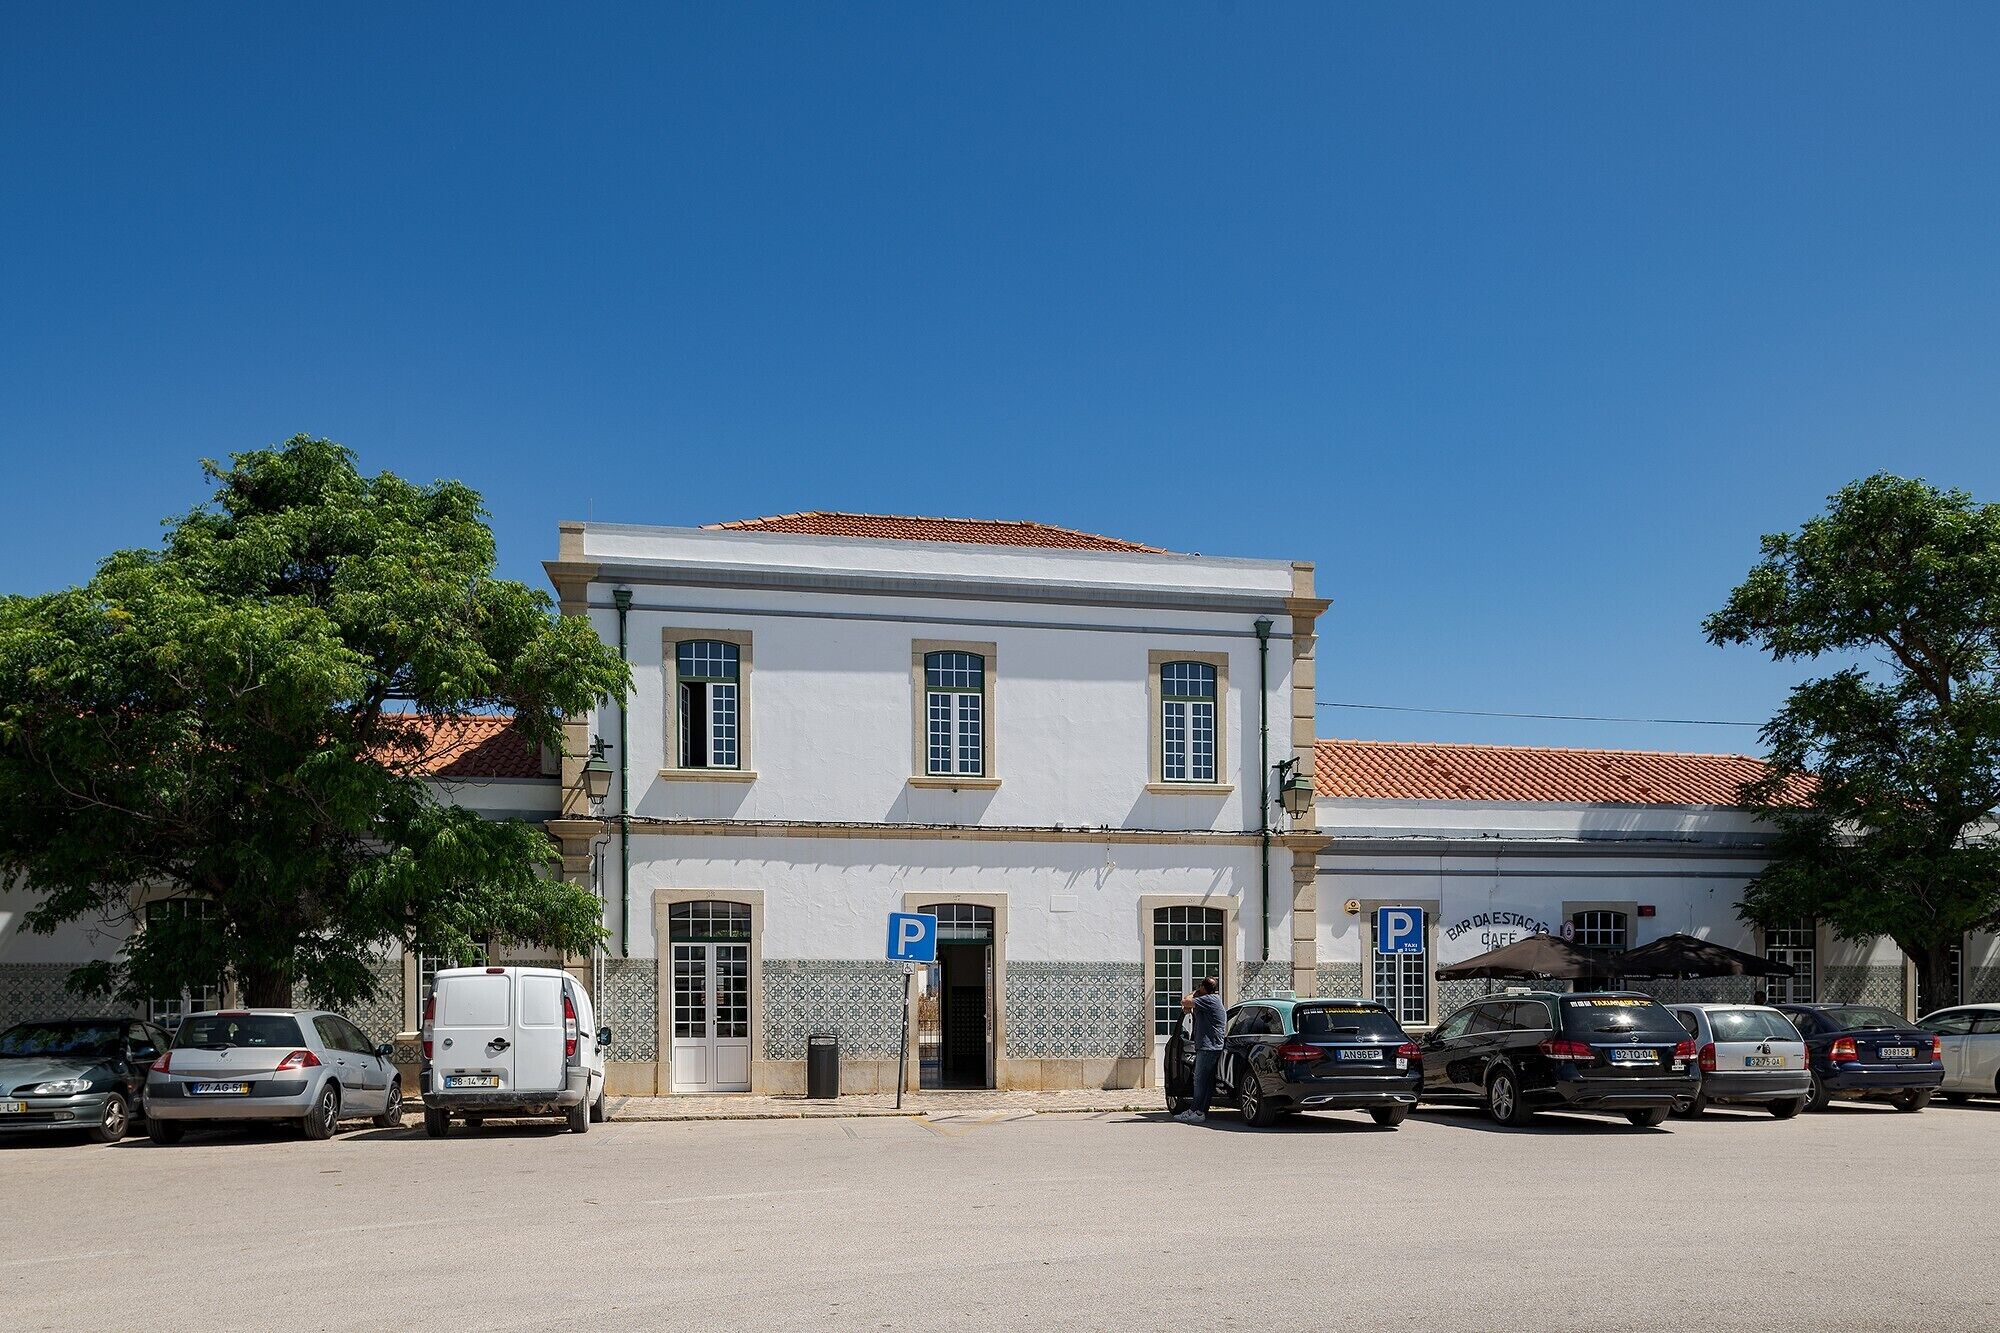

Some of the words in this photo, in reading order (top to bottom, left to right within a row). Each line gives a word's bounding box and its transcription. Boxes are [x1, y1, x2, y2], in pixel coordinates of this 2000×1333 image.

[897, 917, 926, 956] P
[1388, 911, 1413, 950] P
[1446, 919, 1472, 942] BAR
[1472, 912, 1491, 928] DA
[1481, 929, 1517, 945] CAFÉ
